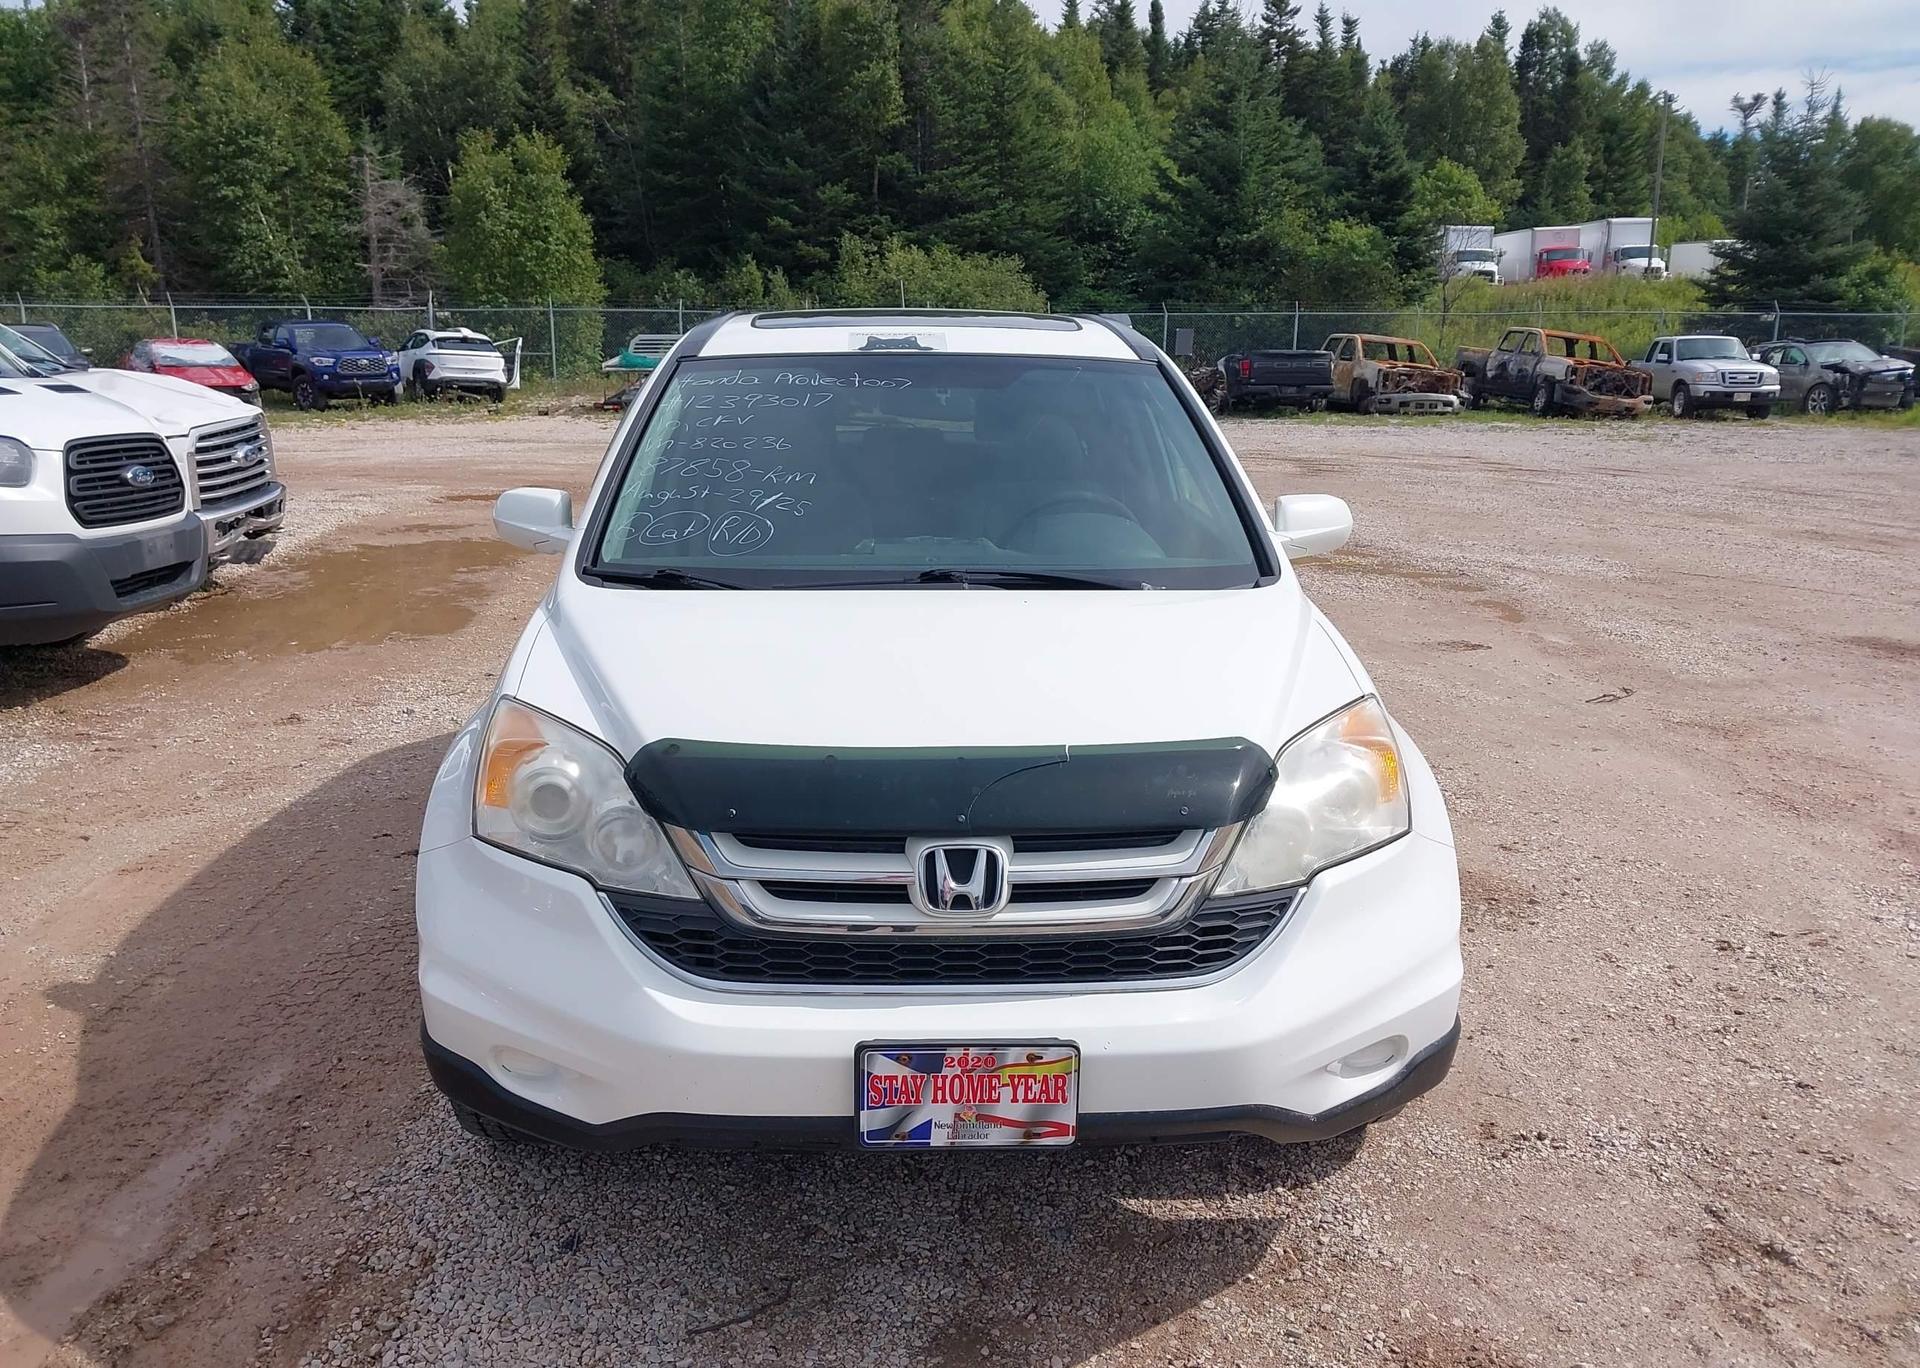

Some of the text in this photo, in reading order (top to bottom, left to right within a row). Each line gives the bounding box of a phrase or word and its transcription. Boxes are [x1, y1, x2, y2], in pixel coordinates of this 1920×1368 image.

[944, 1055, 997, 1068] 2020
[868, 1073, 1068, 1105] STAY HOME YEAR
[946, 1131, 990, 1140] Labrador
